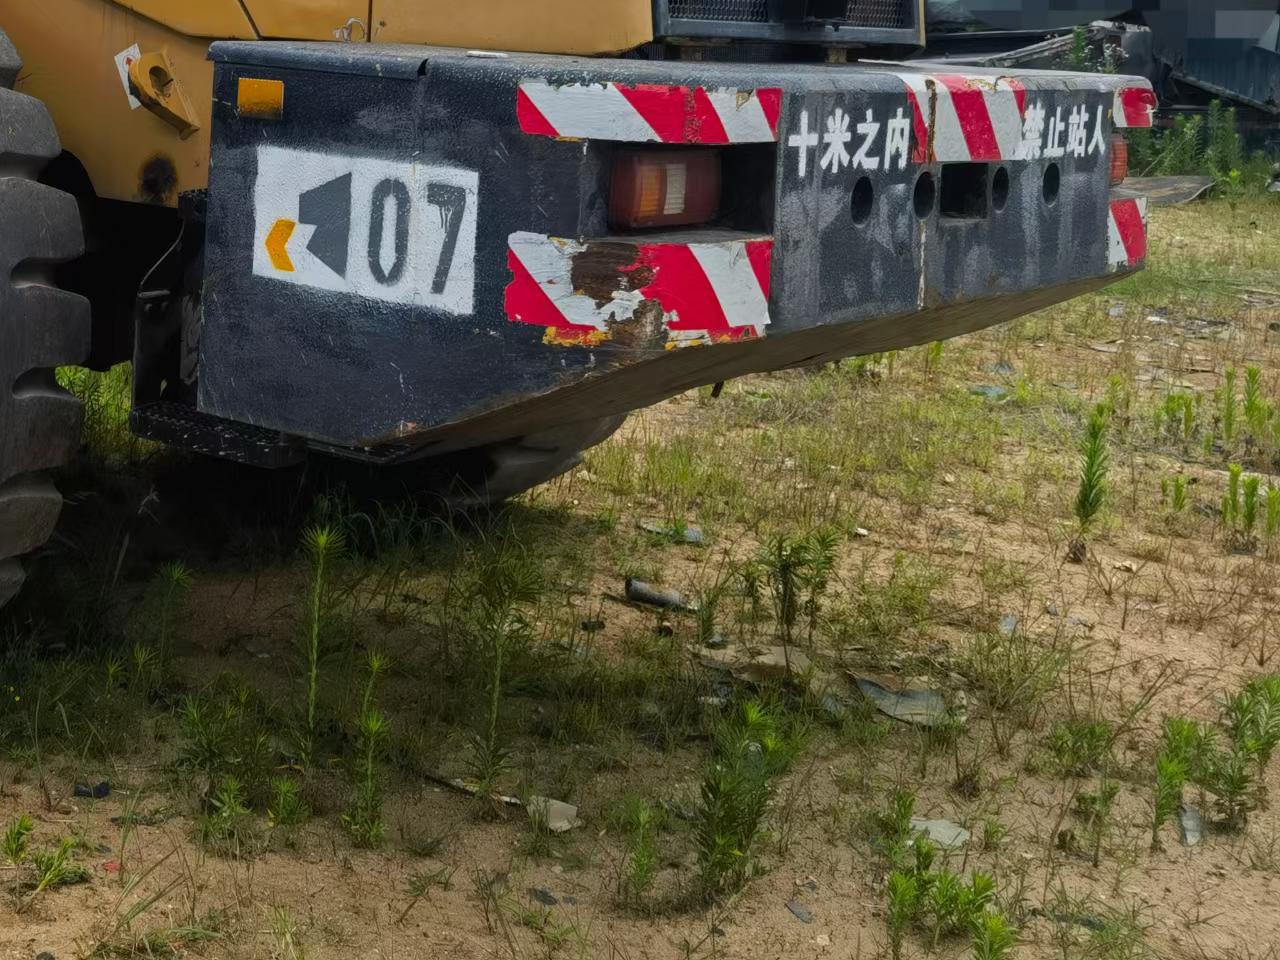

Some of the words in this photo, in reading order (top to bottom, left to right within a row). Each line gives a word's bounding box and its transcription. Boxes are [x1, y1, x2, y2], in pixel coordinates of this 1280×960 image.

[787, 106, 911, 178] 十米之内
[1017, 98, 1106, 161] 禁止站人
[367, 177, 467, 295] 07
